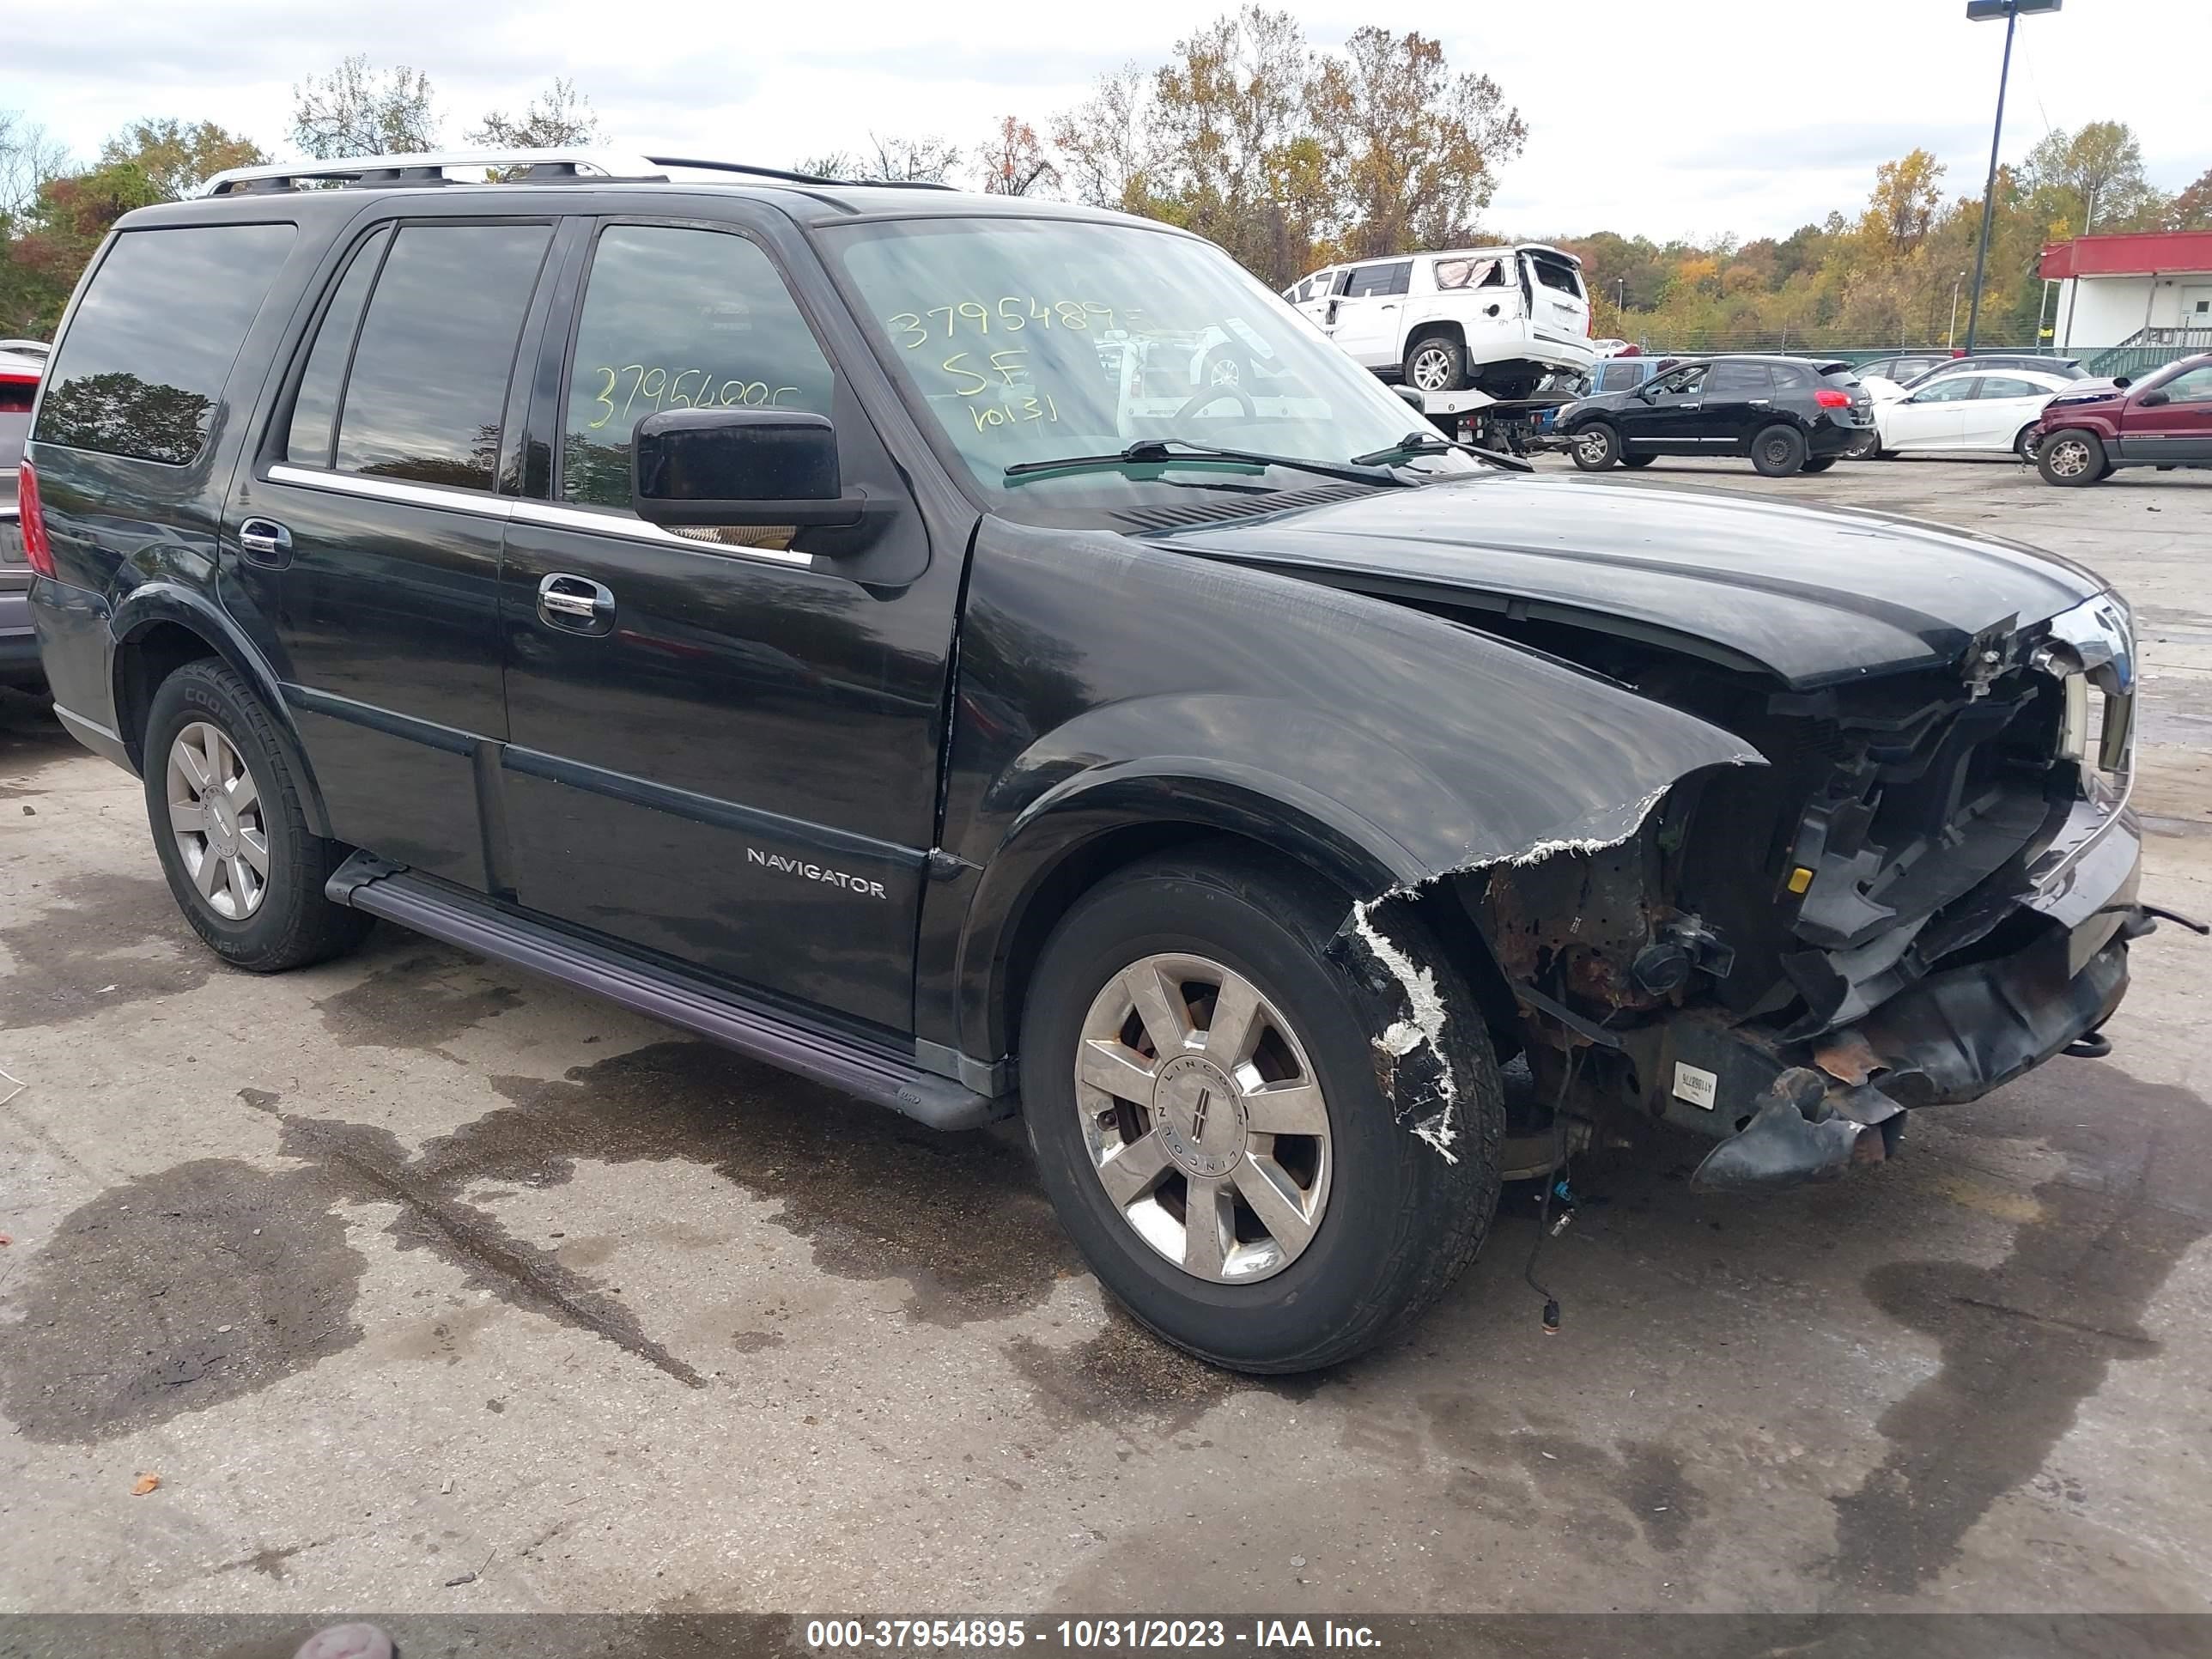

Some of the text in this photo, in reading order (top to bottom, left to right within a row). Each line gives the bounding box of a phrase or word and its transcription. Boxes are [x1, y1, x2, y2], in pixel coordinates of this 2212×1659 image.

[746, 847, 887, 900] NAVIGATOR
[1164, 1060, 1243, 1126] LINCOLN
[1158, 1106, 1237, 1170] LINCOLN
